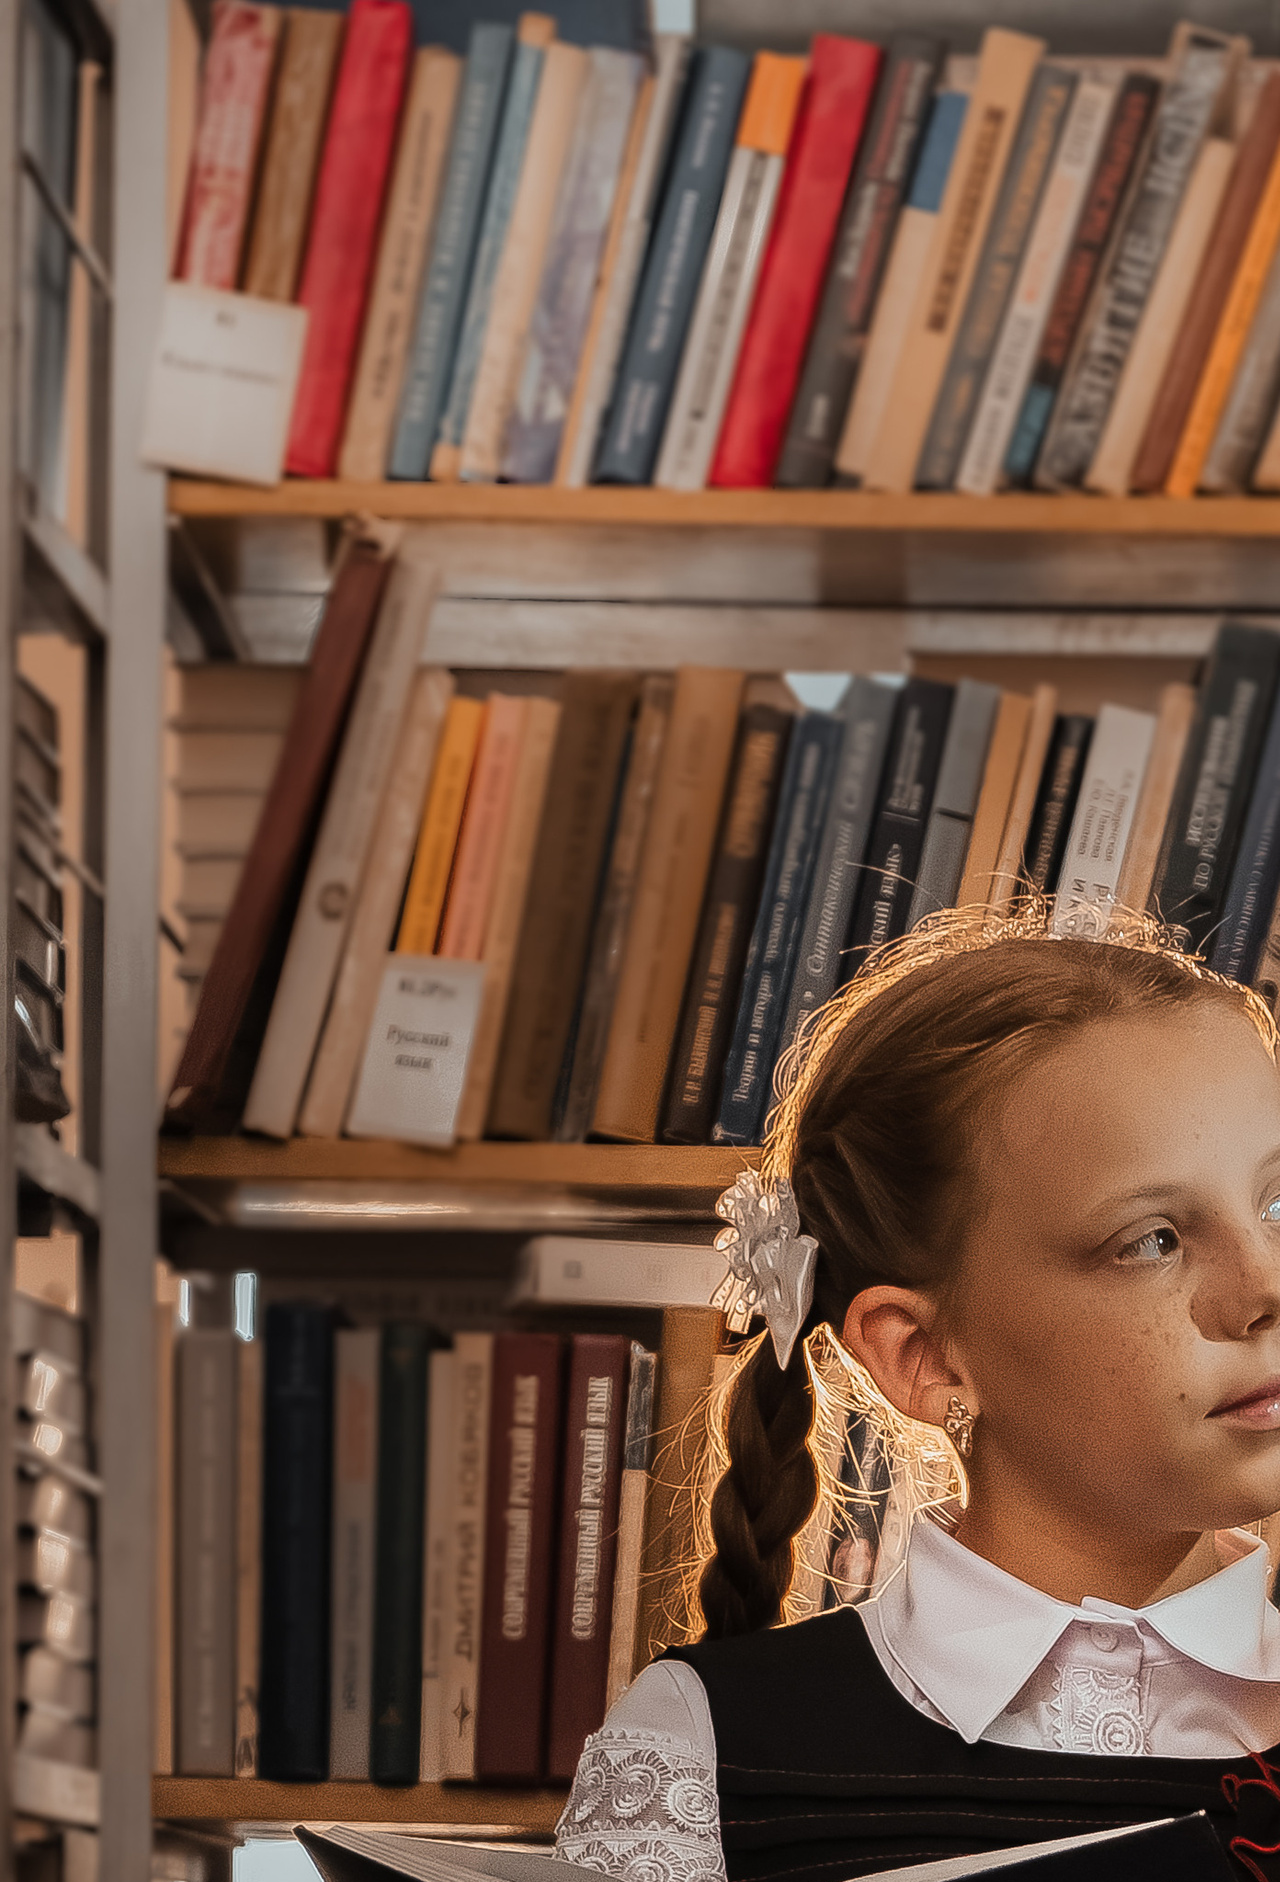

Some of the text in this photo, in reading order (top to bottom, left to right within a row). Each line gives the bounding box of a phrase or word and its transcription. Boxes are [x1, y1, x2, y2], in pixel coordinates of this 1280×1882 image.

[806, 821, 851, 976] Синтаксический
[387, 1025, 451, 1047] Русский
[395, 1054, 433, 1069] язык
[509, 1427, 534, 1505] РУССКИЙ
[572, 1376, 611, 1638] СОВРЕМЕННЫЙ РУССКИЙ ЯЗЫК
[455, 1522, 474, 1659] ДМИТРИЙ
[503, 1508, 530, 1638] СОВРЕМЕННЫЙ
